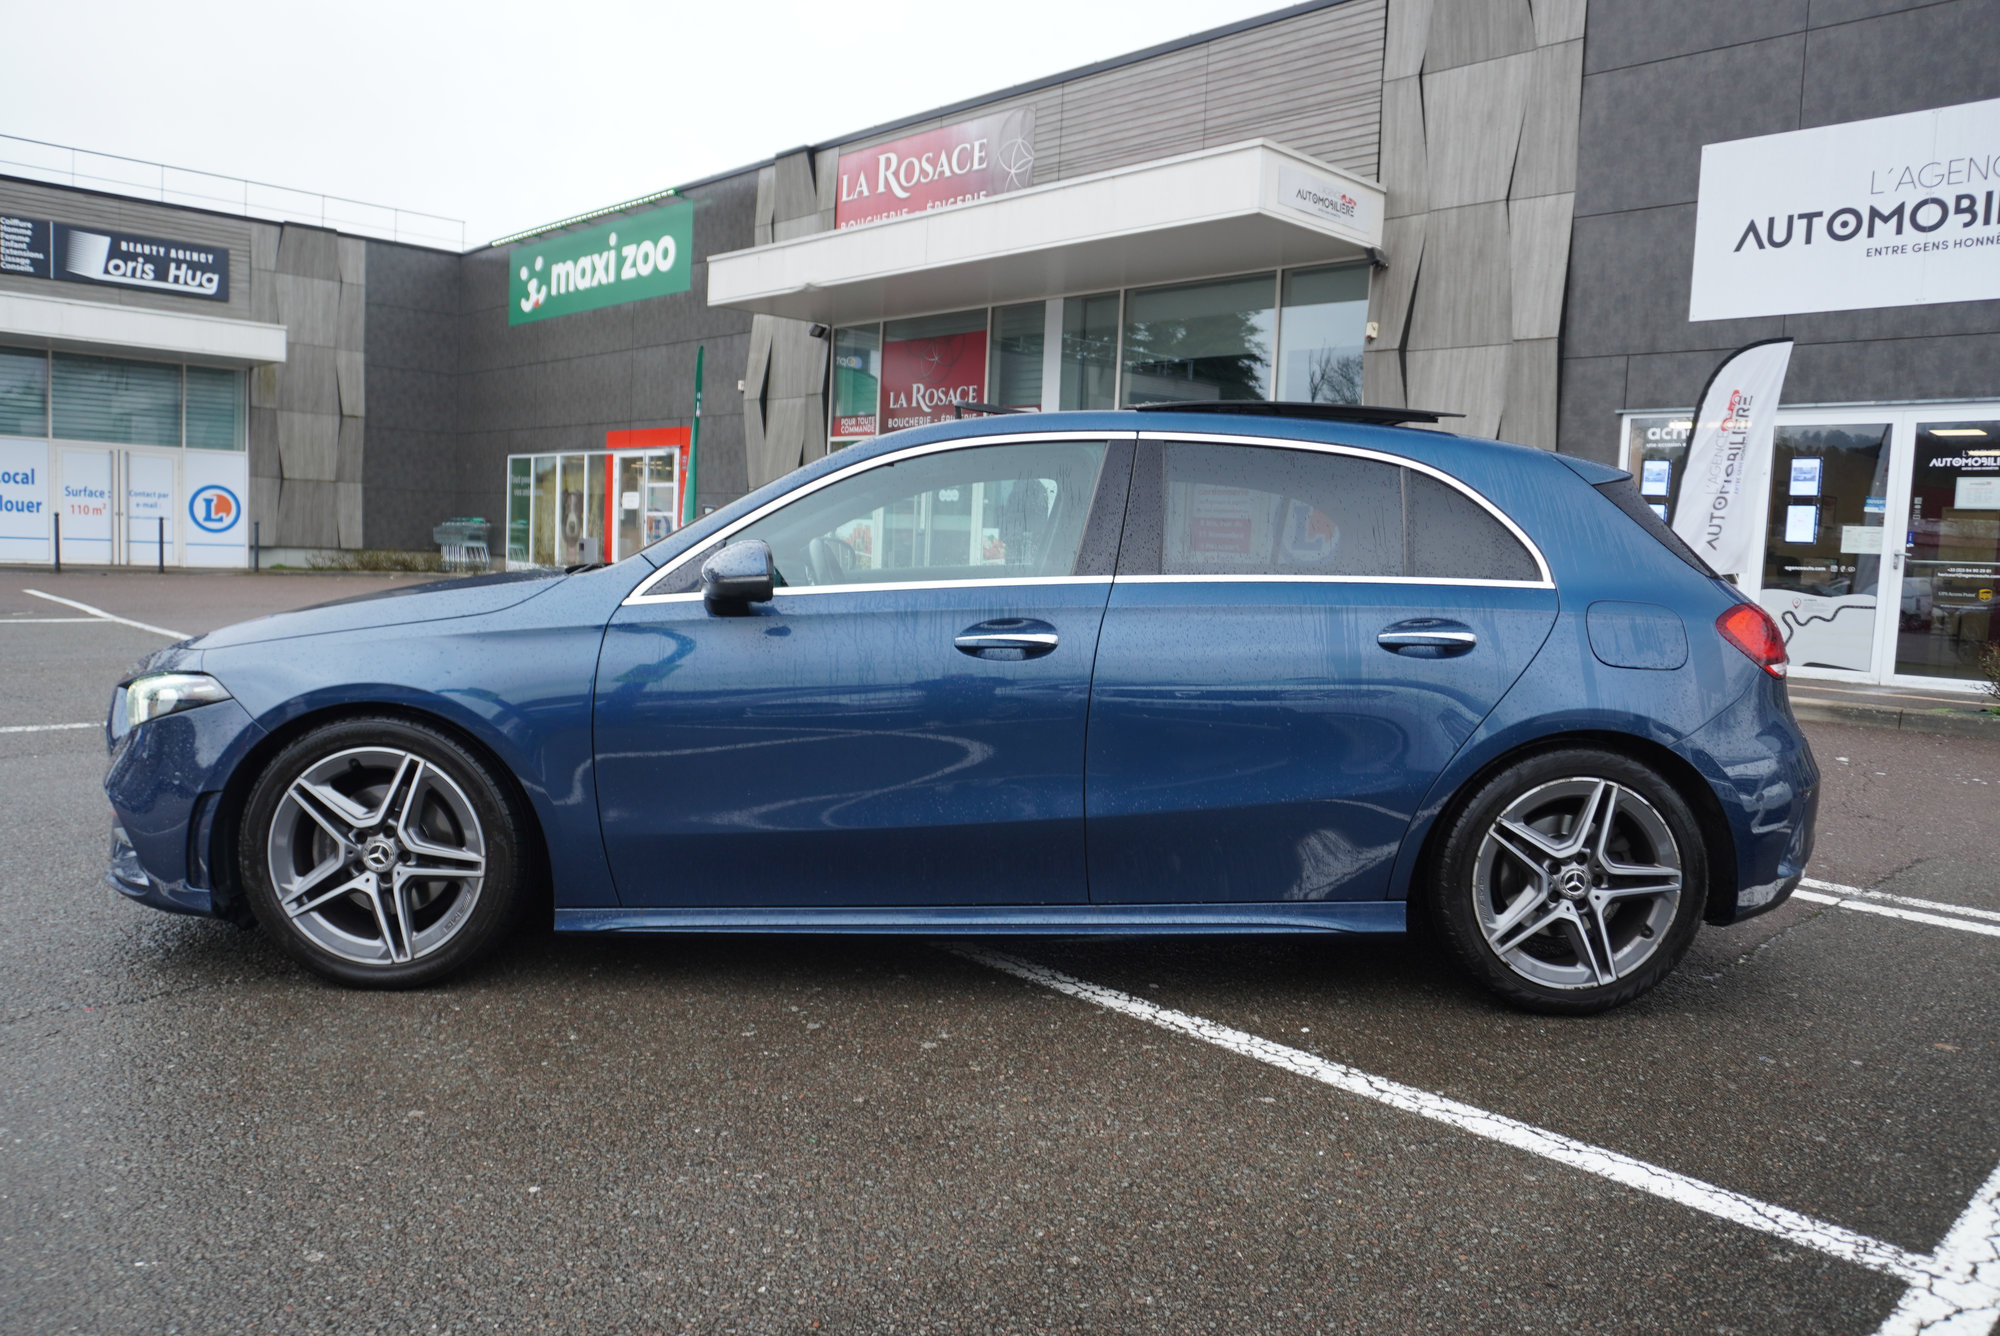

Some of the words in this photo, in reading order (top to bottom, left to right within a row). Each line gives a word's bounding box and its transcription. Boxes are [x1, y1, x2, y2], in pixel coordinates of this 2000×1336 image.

[841, 172, 870, 202] LA
[877, 138, 988, 199] ROSACE
[120, 240, 165, 257] BEAUTY
[169, 248, 214, 265] AGENCY
[1866, 243, 1908, 258] ENTRE
[1911, 238, 1950, 253] GENS
[551, 232, 617, 296] maxi
[621, 235, 676, 281] zoo
[168, 262, 220, 294] Hug
[889, 392, 907, 409] LA
[911, 383, 978, 412] ROSACE
[840, 417, 856, 426] POUR
[857, 416, 875, 425] TOUTE
[840, 424, 875, 434] COMMANDE
[0, 468, 35, 485] ocal
[65, 485, 105, 498] Surface
[71, 504, 90, 515] 110
